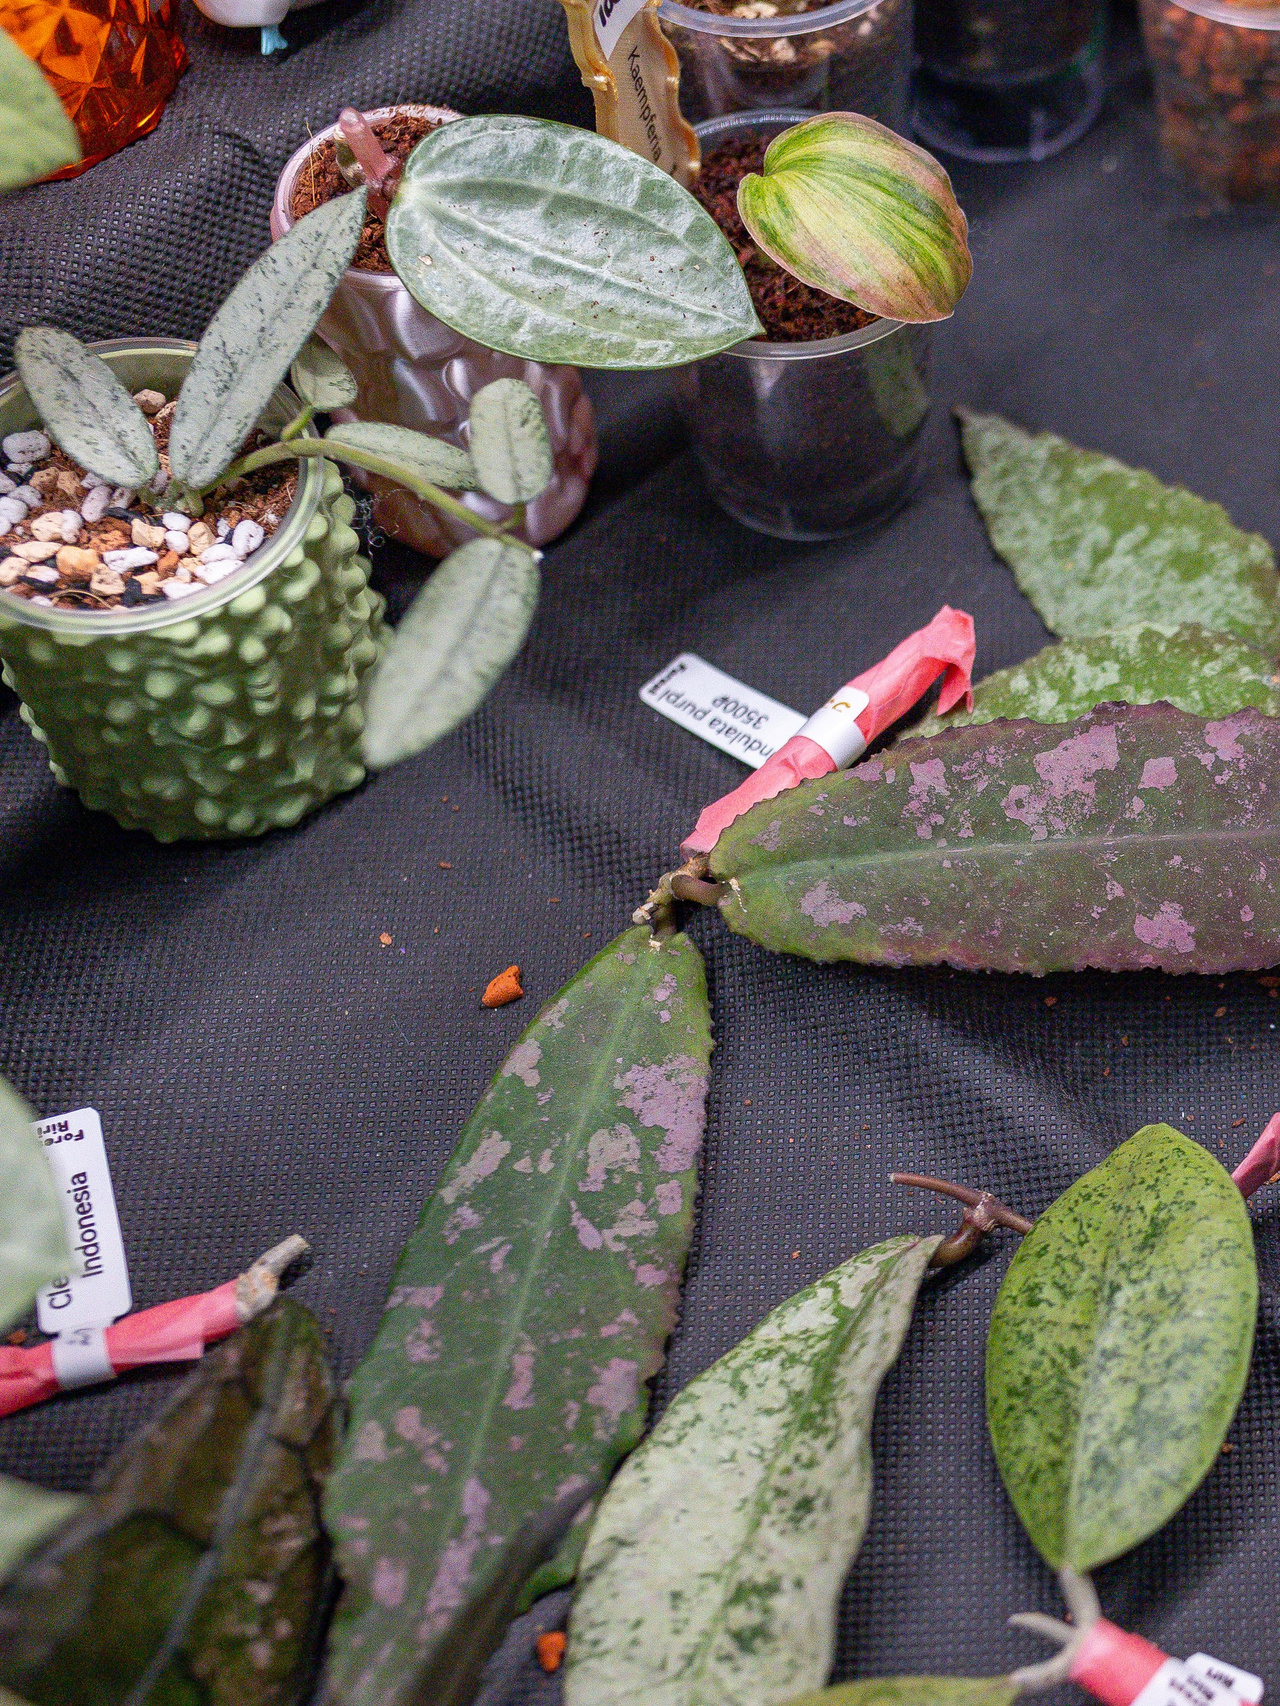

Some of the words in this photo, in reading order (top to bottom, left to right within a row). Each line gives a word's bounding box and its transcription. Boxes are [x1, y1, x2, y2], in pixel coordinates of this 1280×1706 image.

[628, 46, 663, 162] Kaempferia
[709, 717, 776, 757] ndulata
[37, 1120, 69, 1139] Riri
[42, 1129, 85, 1147] Fore
[66, 1171, 103, 1278] Indonesia
[46, 1275, 73, 1310] Cle
